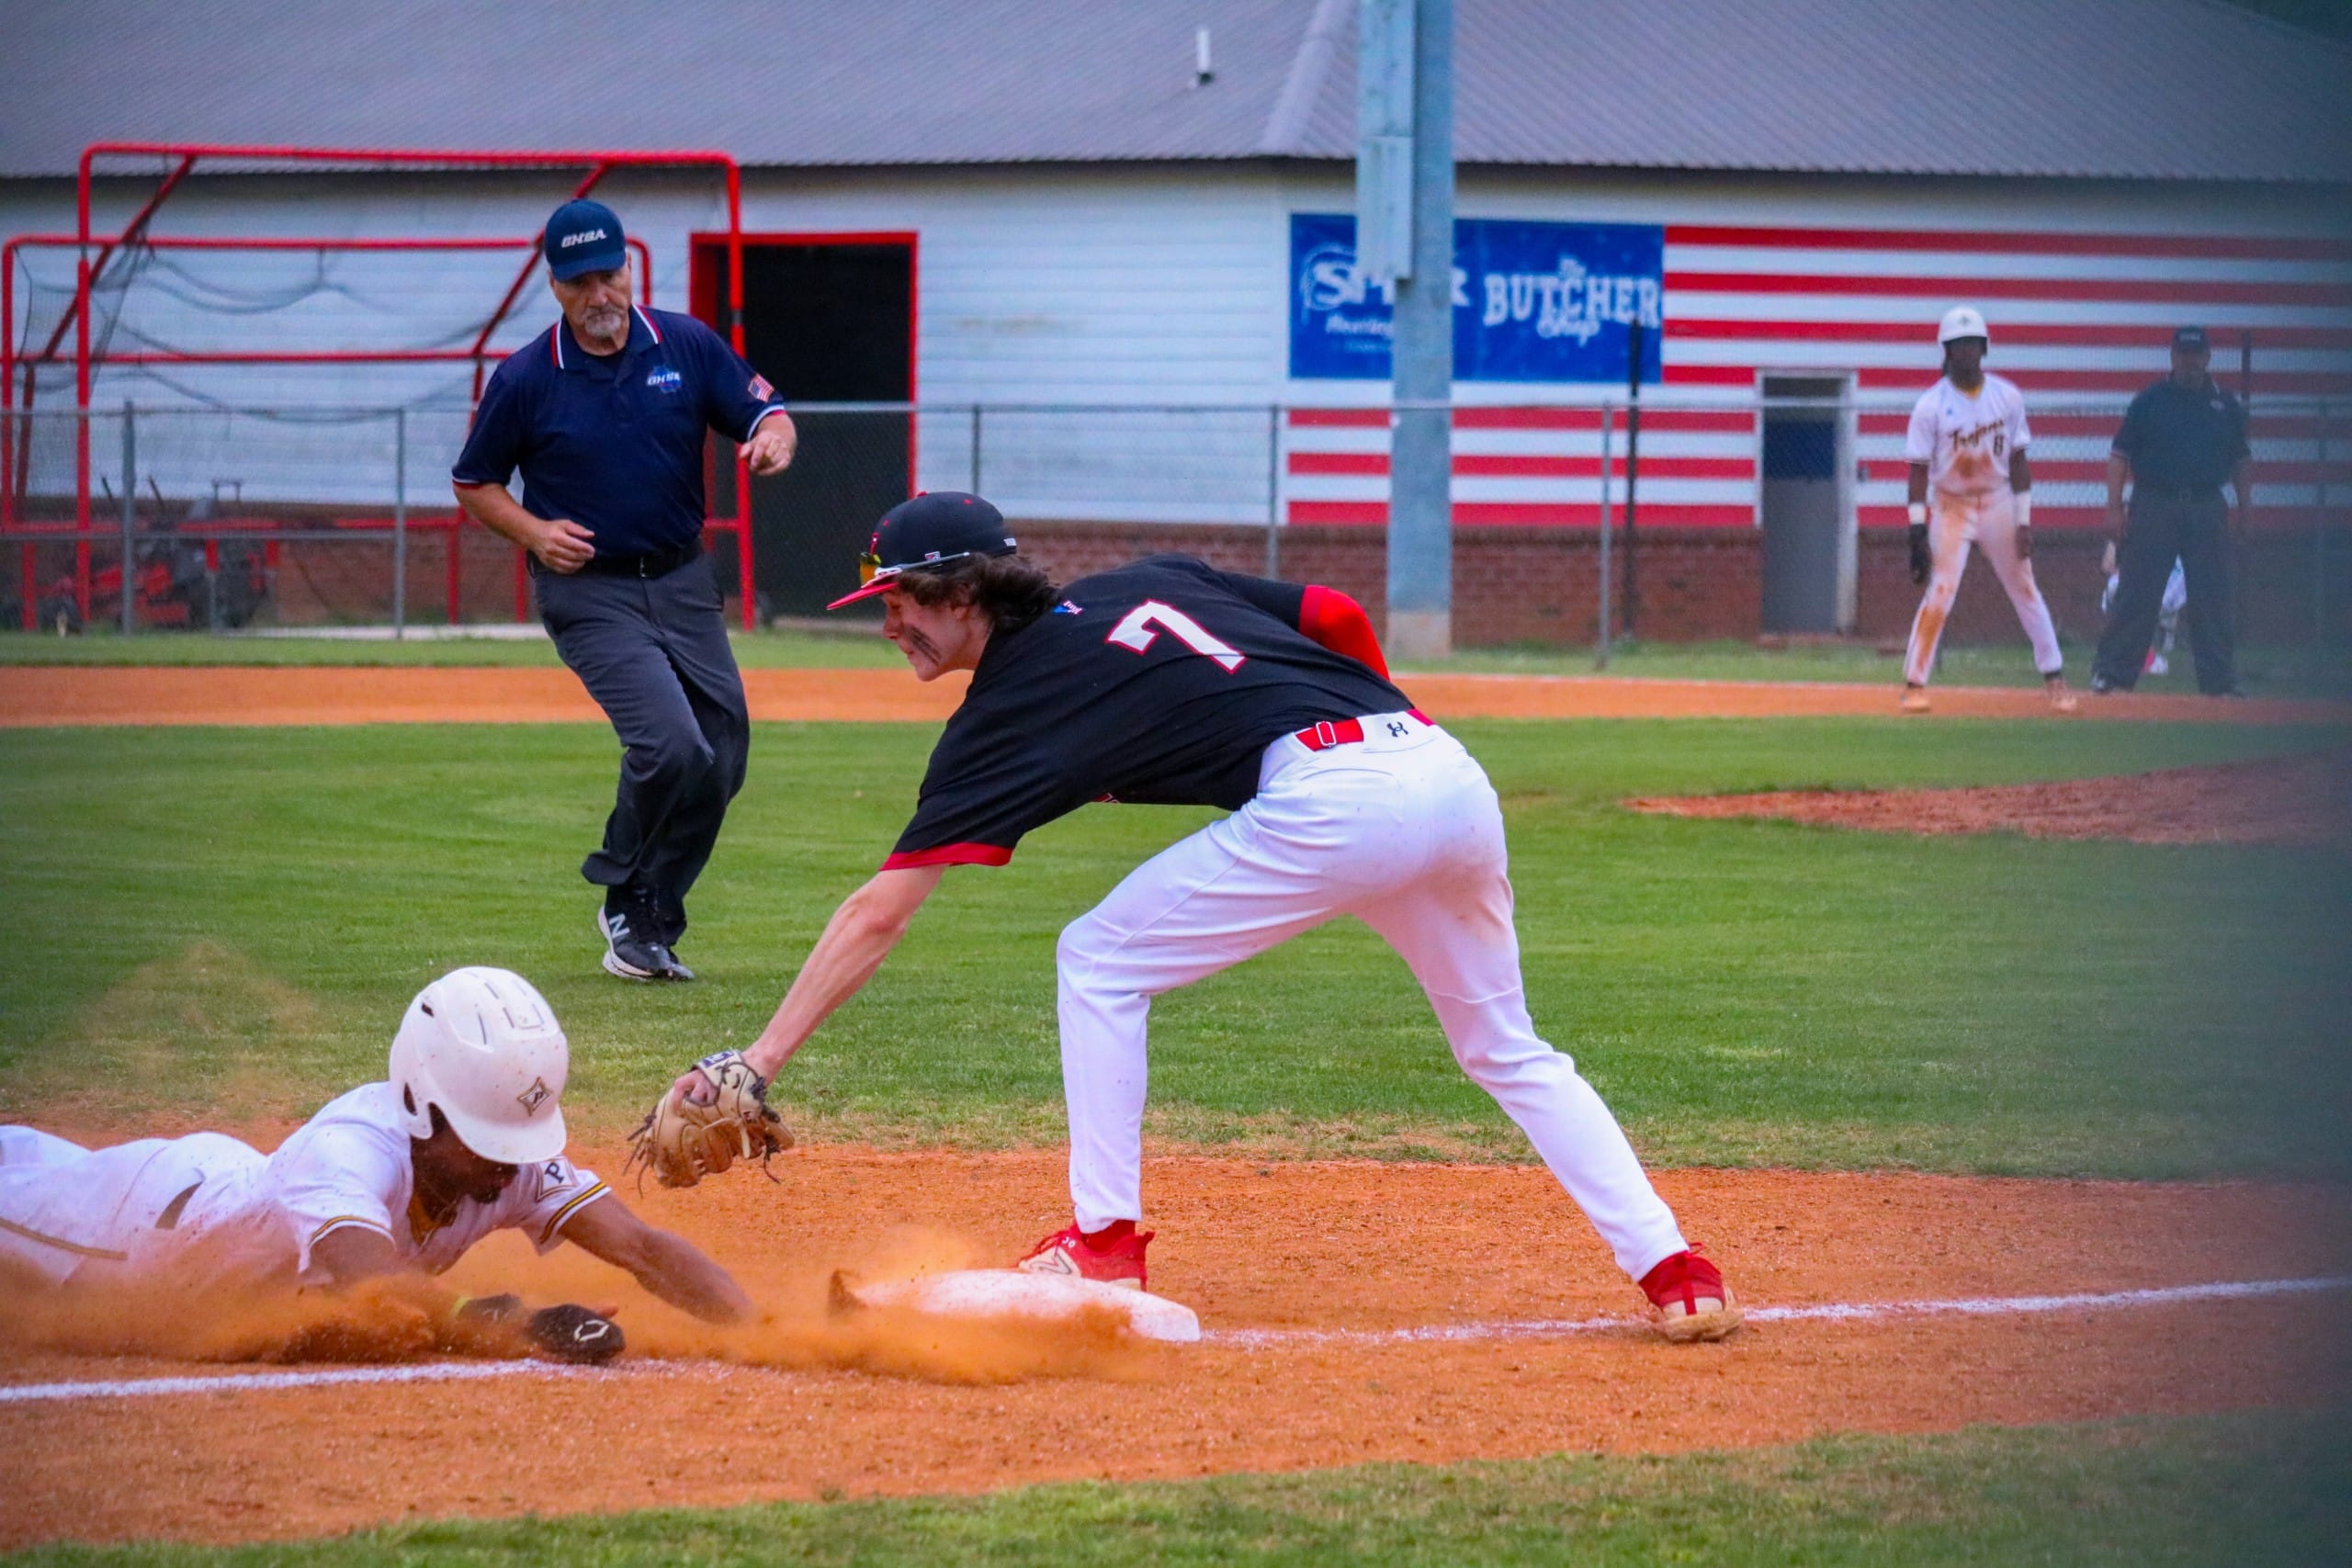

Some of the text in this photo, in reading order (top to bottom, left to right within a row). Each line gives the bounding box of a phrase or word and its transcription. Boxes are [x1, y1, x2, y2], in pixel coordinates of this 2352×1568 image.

[1483, 273, 1660, 330] BUTCHER
[1104, 598, 1250, 675] 7
[544, 1161, 565, 1184] P
